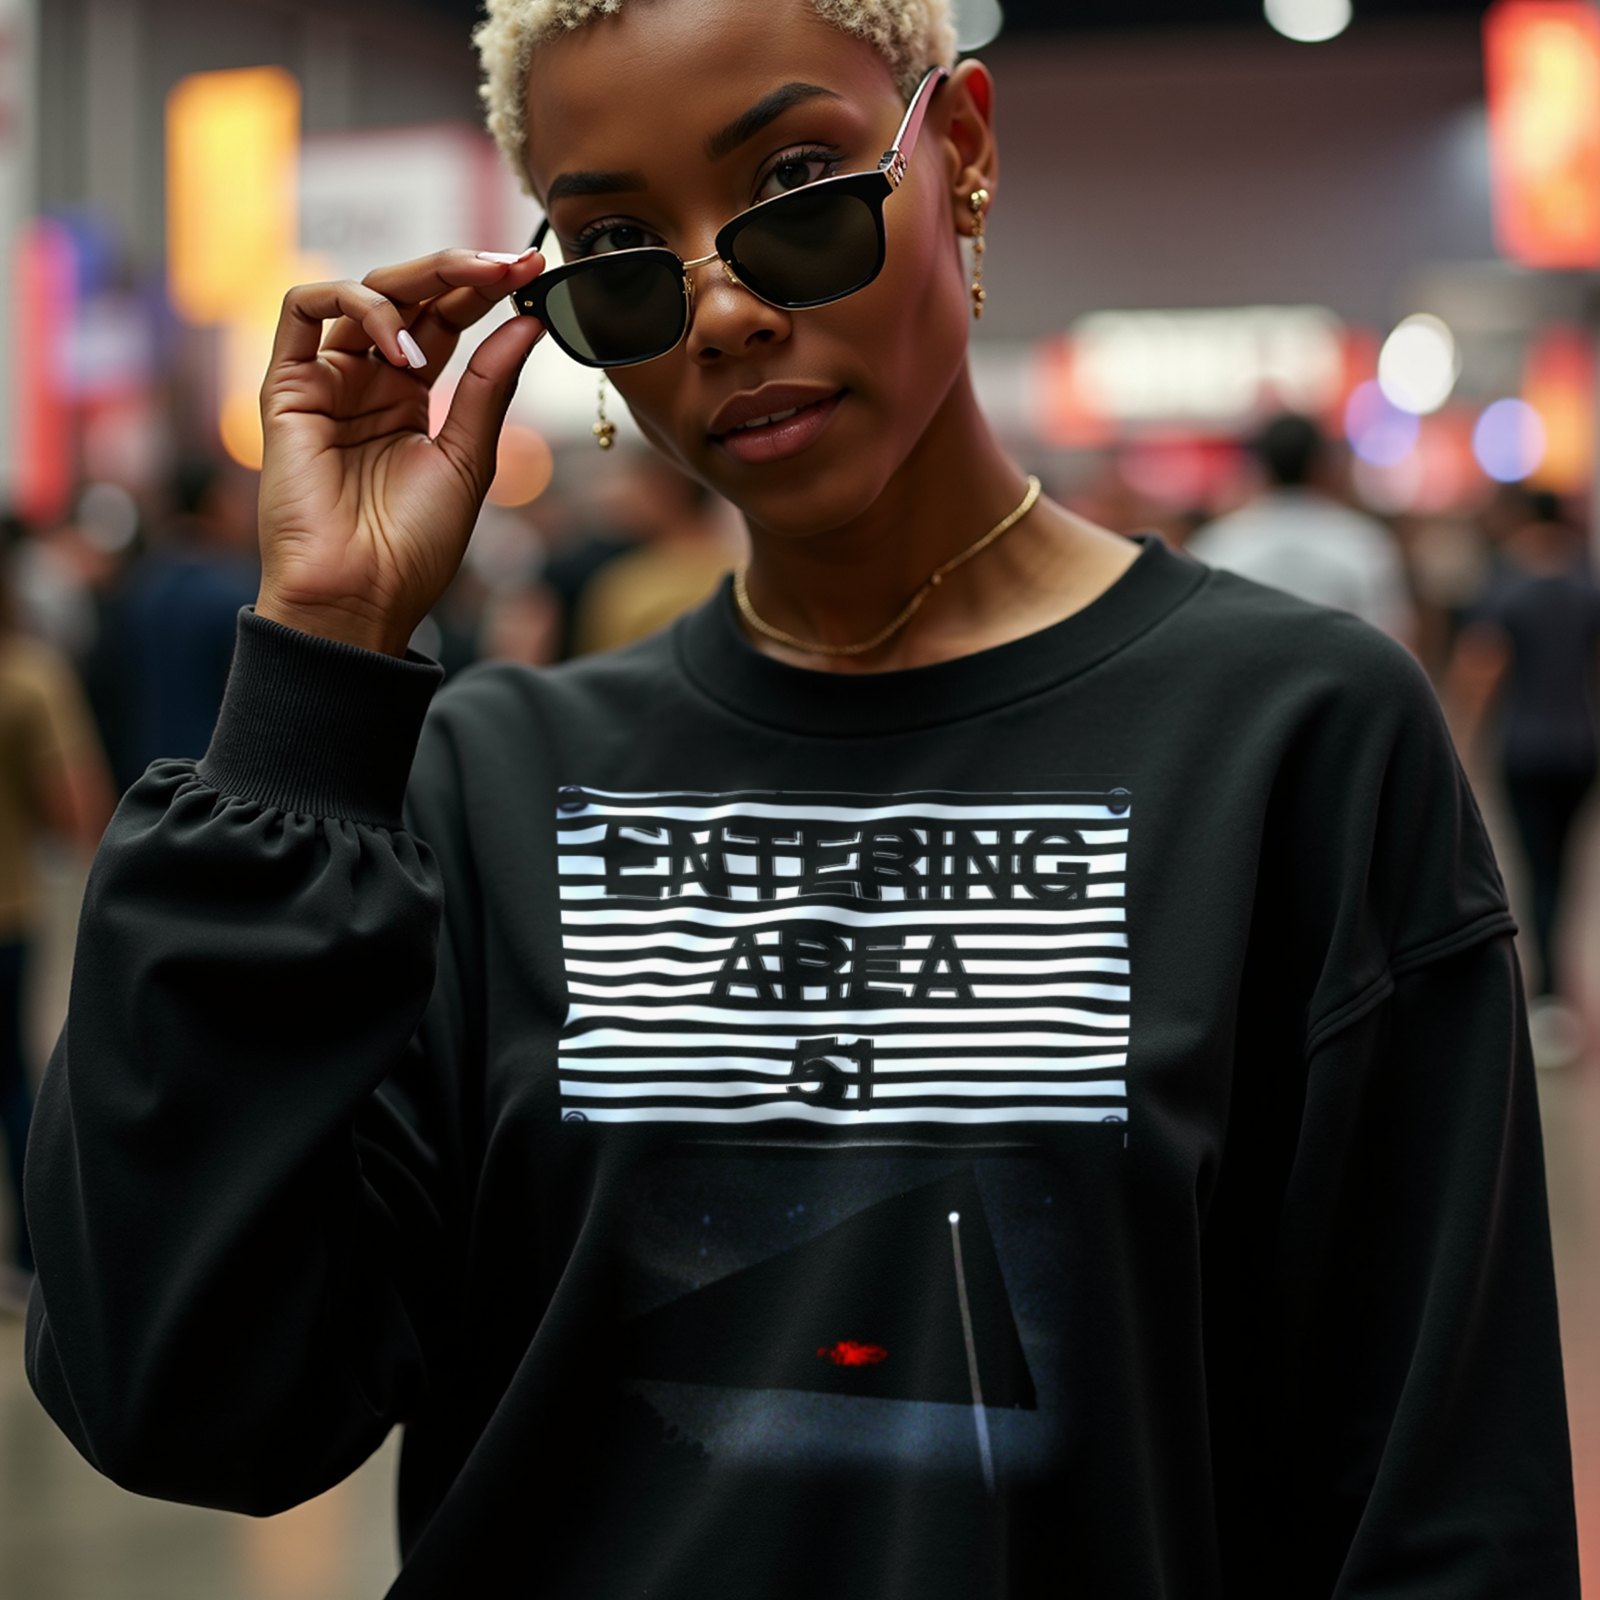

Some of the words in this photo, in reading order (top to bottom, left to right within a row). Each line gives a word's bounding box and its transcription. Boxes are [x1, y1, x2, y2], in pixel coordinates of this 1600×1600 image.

[603, 824, 1090, 901] ENTERING
[709, 928, 976, 1001] AREA
[788, 1036, 875, 1111] 51
